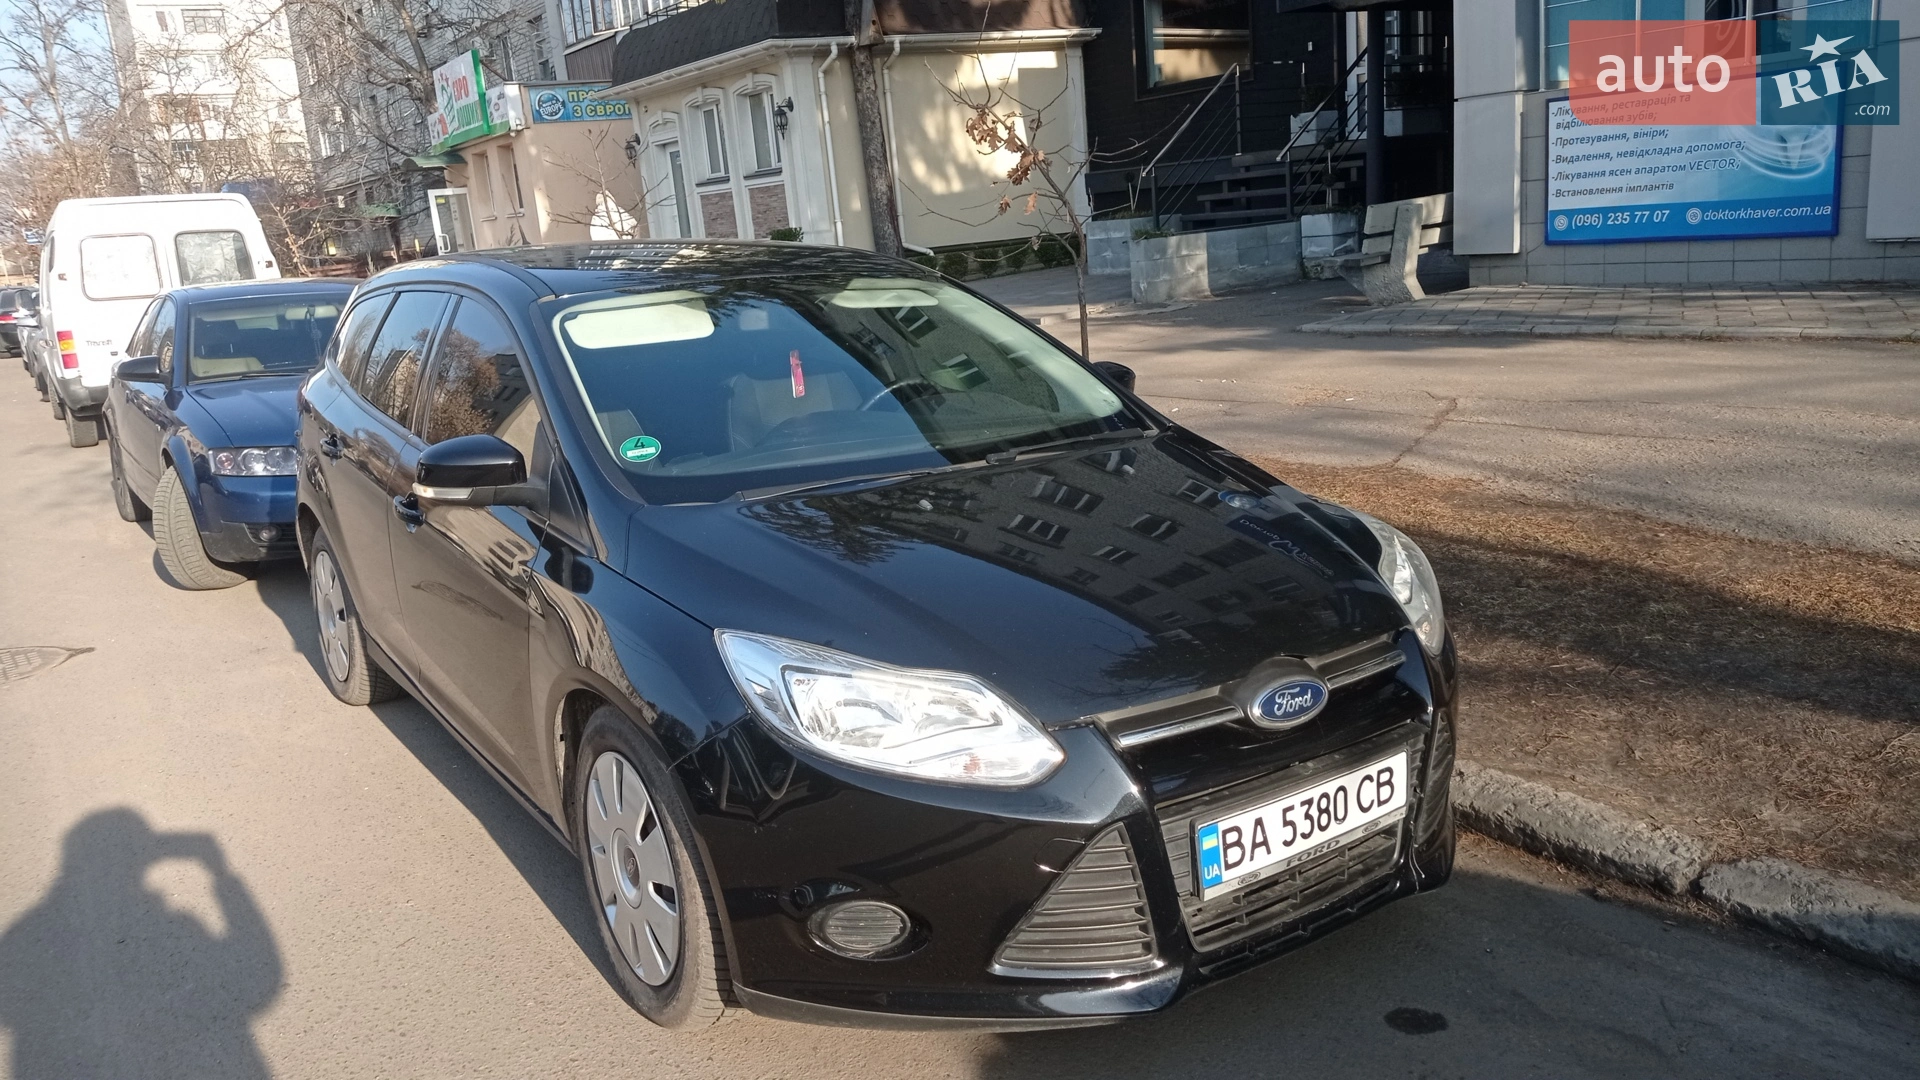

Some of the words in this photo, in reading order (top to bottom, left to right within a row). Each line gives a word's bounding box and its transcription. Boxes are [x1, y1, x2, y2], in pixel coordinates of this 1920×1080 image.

[1612, 94, 1676, 113] реставрація
[1679, 94, 1691, 103] та
[1551, 132, 1630, 149] -Протезування,
[1633, 127, 1669, 140] вініри;
[1551, 152, 1613, 165] -Видалення,
[1616, 144, 1683, 159] невідкладна
[1685, 140, 1746, 155] допомога;
[1551, 168, 1606, 183] -Лікування
[1608, 166, 1632, 177] ясен
[1634, 164, 1687, 177] апаратом
[1688, 158, 1741, 171] VECTOR;
[1551, 184, 1624, 198] -Встановлення
[1625, 180, 1674, 194] імплантів
[1571, 212, 1603, 229] (096)
[1607, 211, 1630, 225] 235
[1634, 211, 1650, 224] 77
[1653, 210, 1670, 223] 07
[1704, 204, 1832, 221] doktorkhaver.com.ua
[634, 438, 646, 449] 4
[1273, 686, 1314, 716] Ford
[1221, 816, 1272, 872] BA
[1281, 784, 1349, 848] 5380
[1356, 765, 1395, 814] CB
[1285, 839, 1341, 868] FORD
[1204, 865, 1221, 880] UA
